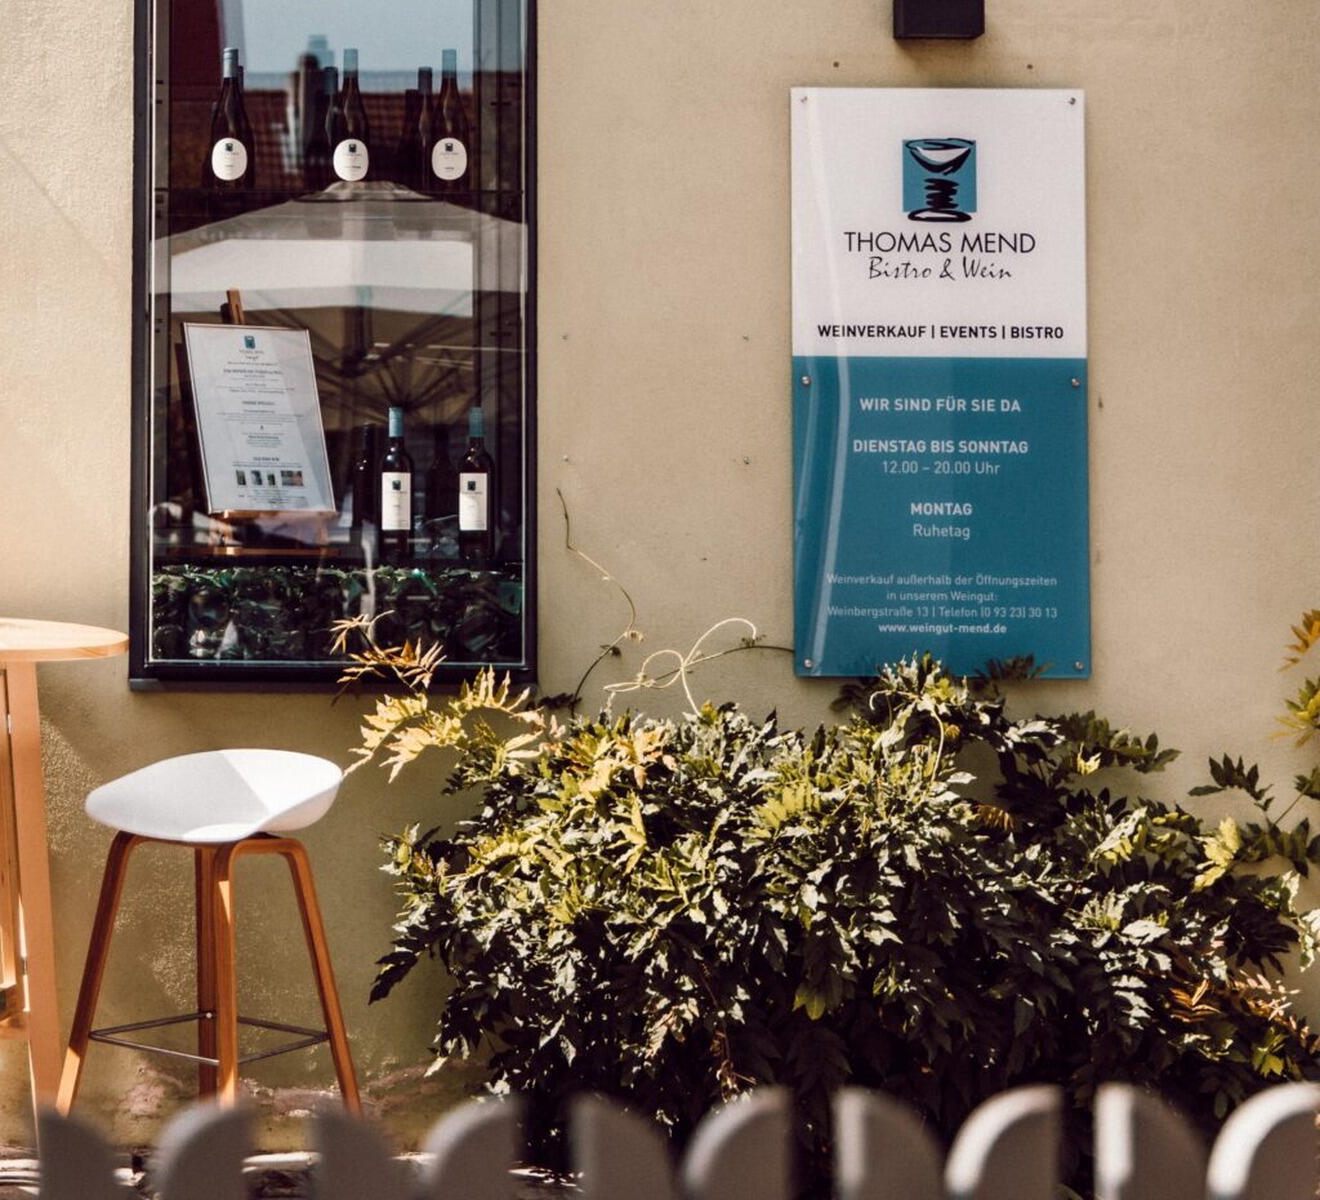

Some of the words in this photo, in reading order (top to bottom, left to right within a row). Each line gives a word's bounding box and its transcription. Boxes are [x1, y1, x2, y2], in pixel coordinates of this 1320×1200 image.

[844, 231, 953, 254] THOMAS
[960, 231, 1036, 254] MEND
[867, 256, 932, 280] Bistro
[939, 258, 956, 281] &
[962, 258, 1012, 280] Wein
[817, 324, 927, 339] WEINVERKAUF
[939, 325, 998, 340] EVENTS
[1010, 325, 1064, 340] BISTRO
[859, 397, 891, 413] WIR
[894, 397, 932, 413] SIND
[936, 395, 967, 413] FÜR
[970, 397, 996, 413] SIE
[1000, 398, 1022, 413] DA
[852, 439, 927, 454] DIENSTAG
[930, 439, 955, 454] BIS
[958, 440, 1029, 454] SONNTAG
[882, 460, 919, 475] 12.00
[933, 460, 971, 475] 20.00
[974, 460, 1001, 475] Uhr
[910, 501, 973, 516] MONTAG
[912, 523, 971, 540] Ruhetag
[826, 573, 894, 586] Weinverkauf
[896, 573, 952, 586] außerhalb
[954, 574, 973, 586] der
[975, 573, 1058, 588] Öffnungszeiten
[886, 590, 897, 601] in
[899, 592, 948, 602] unserem
[950, 590, 998, 604] Weingut:
[827, 605, 914, 620] Weinbergstraße
[916, 606, 929, 618] 13
[938, 606, 978, 618] Telefon
[993, 606, 1007, 618] 93
[1028, 607, 1043, 618] 30
[1045, 607, 1058, 619] 13
[878, 623, 1008, 636] www.weingut-mend.de
